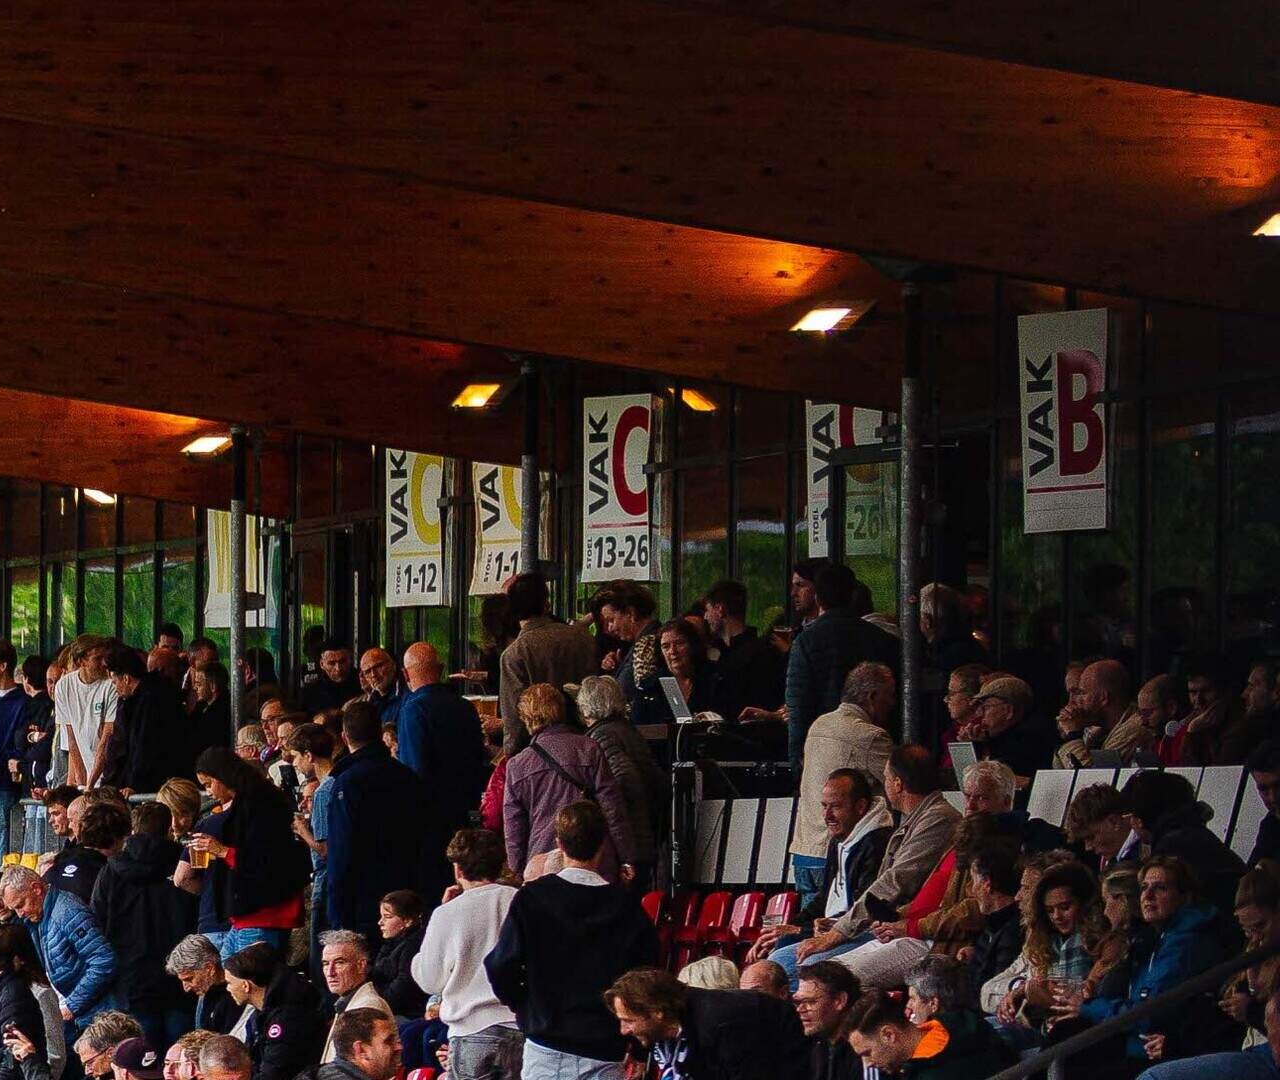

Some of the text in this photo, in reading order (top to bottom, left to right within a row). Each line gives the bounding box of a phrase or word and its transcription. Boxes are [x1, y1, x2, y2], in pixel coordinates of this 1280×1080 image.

[589, 410, 609, 515] VAK
[612, 405, 650, 516] C
[1025, 351, 1105, 477] VAK B
[390, 450, 408, 545] VAK
[404, 562, 437, 593] 1-12
[593, 534, 649, 568] 13-26
